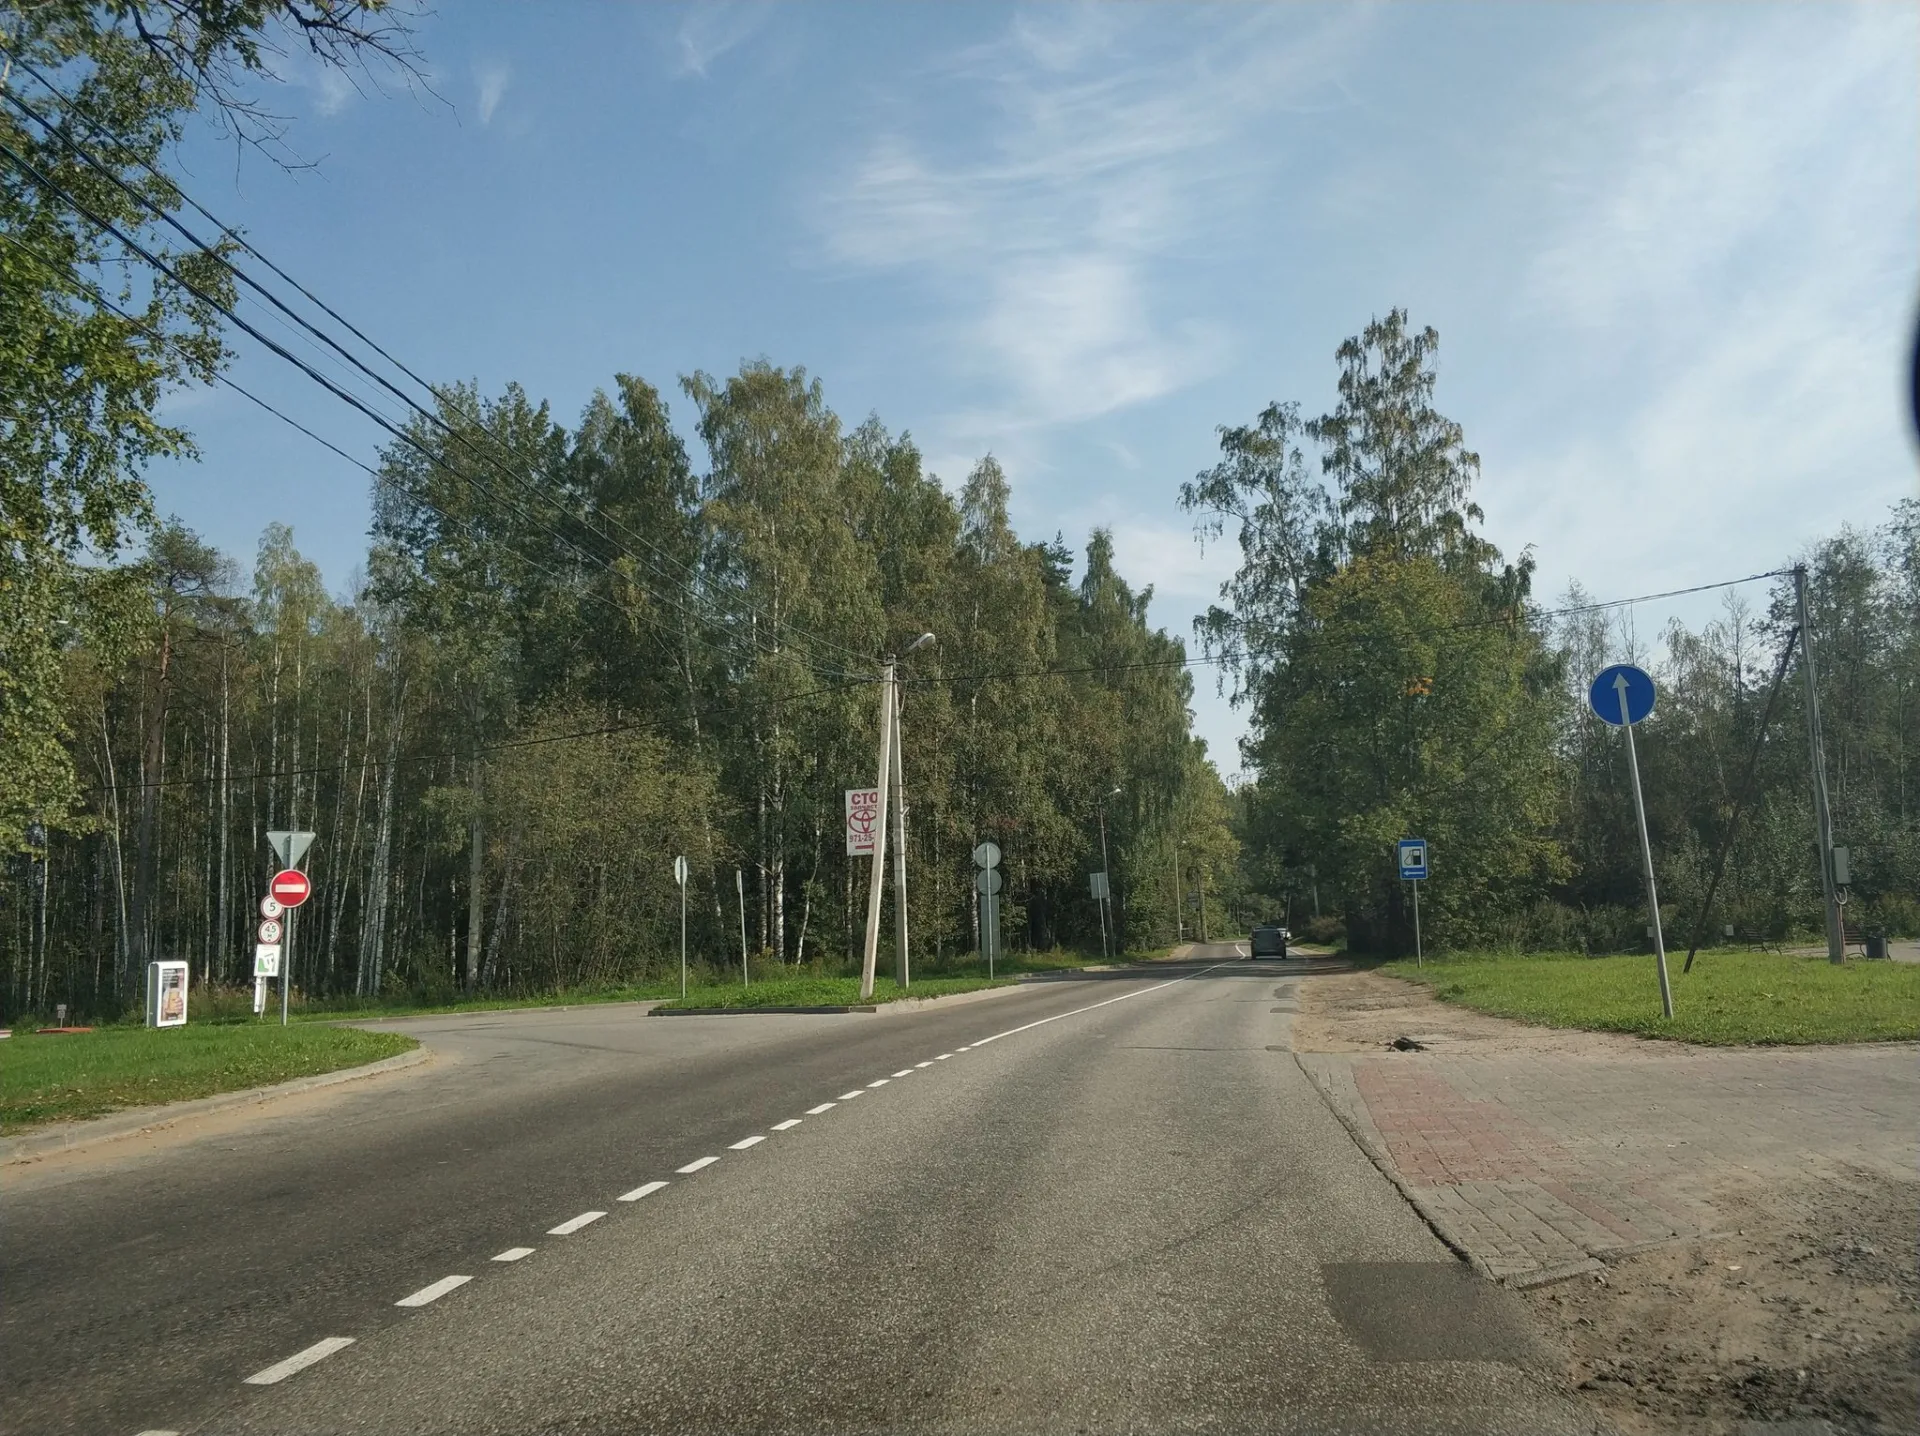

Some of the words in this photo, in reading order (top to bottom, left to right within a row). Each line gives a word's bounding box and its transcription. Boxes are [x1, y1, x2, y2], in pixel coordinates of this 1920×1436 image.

[851, 792, 878, 805] СТО
[849, 834, 874, 843] 971-25-
[269, 902, 276, 912] 5
